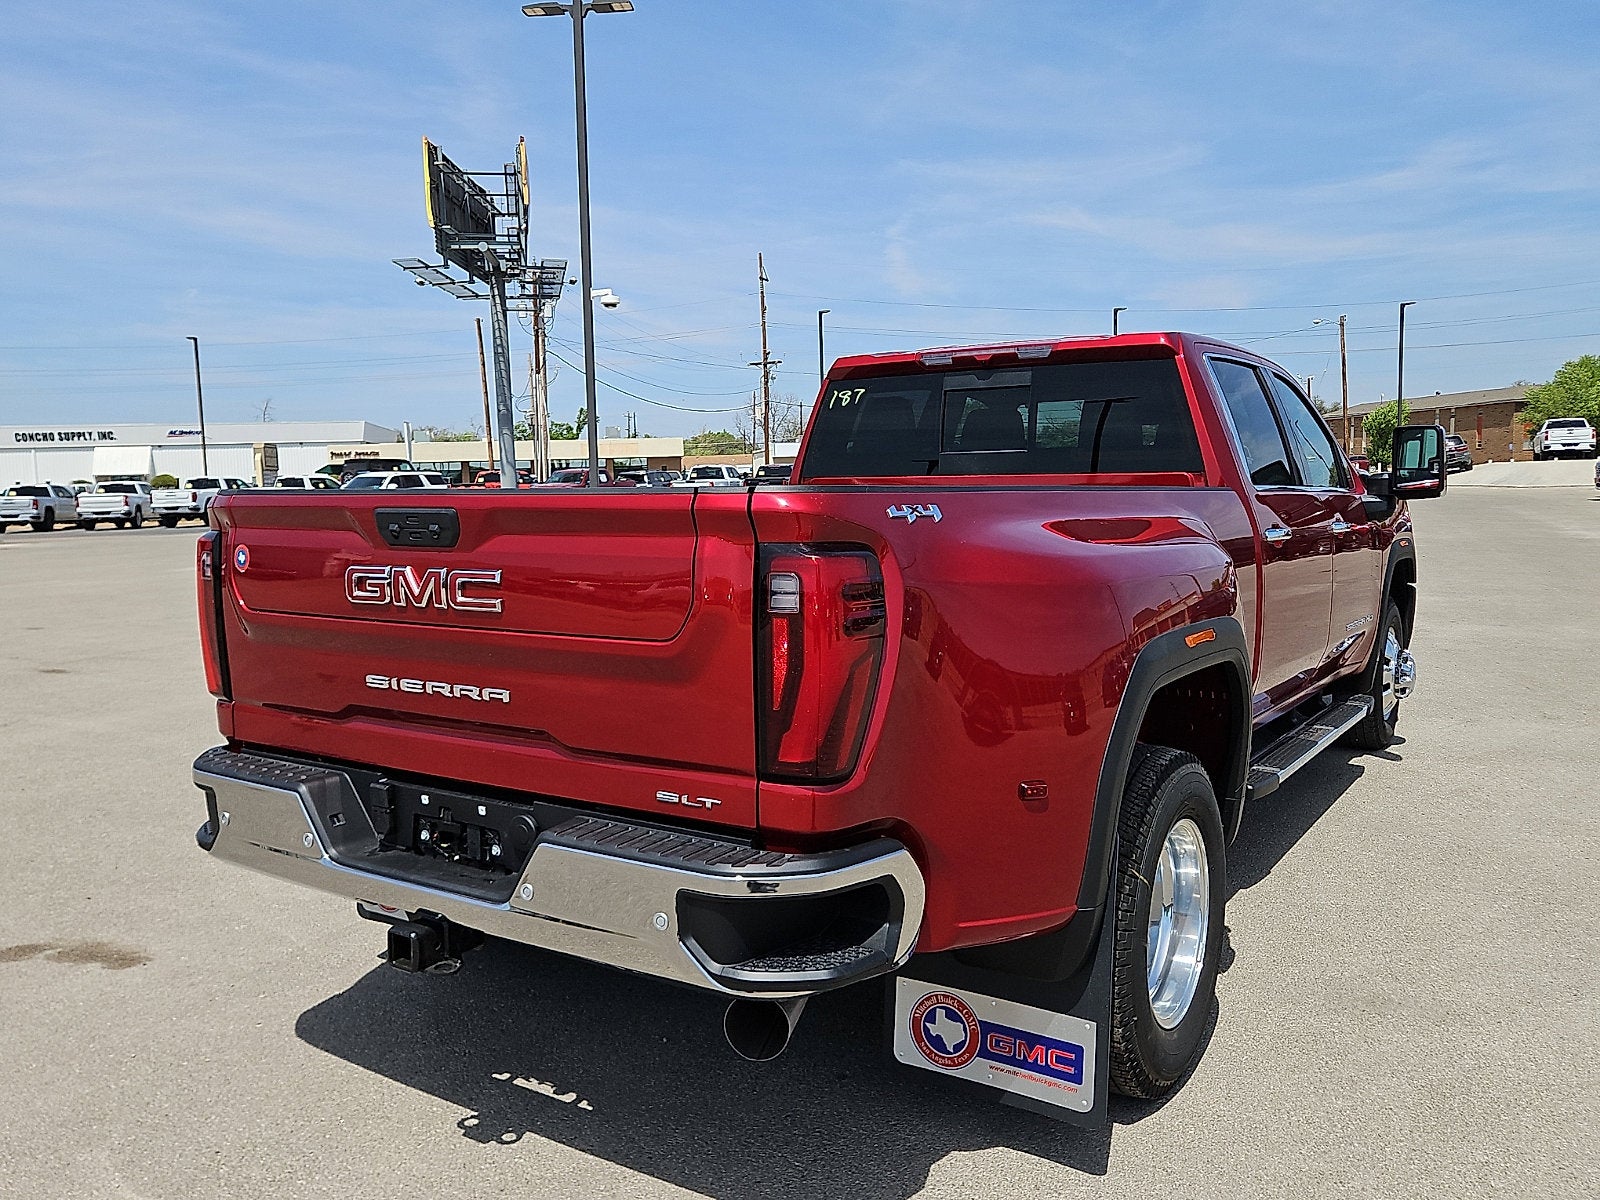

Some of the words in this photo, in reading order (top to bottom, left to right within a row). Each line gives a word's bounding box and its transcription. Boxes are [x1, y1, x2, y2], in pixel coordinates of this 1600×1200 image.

[829, 388, 866, 410] 187
[14, 432, 55, 443] CONCHO
[97, 430, 117, 441] INC.
[344, 565, 503, 613] GMC
[365, 674, 511, 703] SIERRA
[655, 790, 722, 810] SLT
[914, 996, 938, 1018] Mitchell
[937, 994, 960, 1009] Buick
[962, 1009, 978, 1033] GMC
[920, 1041, 930, 1054] San
[954, 1053, 971, 1065] Texas
[987, 1032, 1076, 1075] GMC
[988, 1064, 1078, 1094] www.mitchellbuickgmc.com
